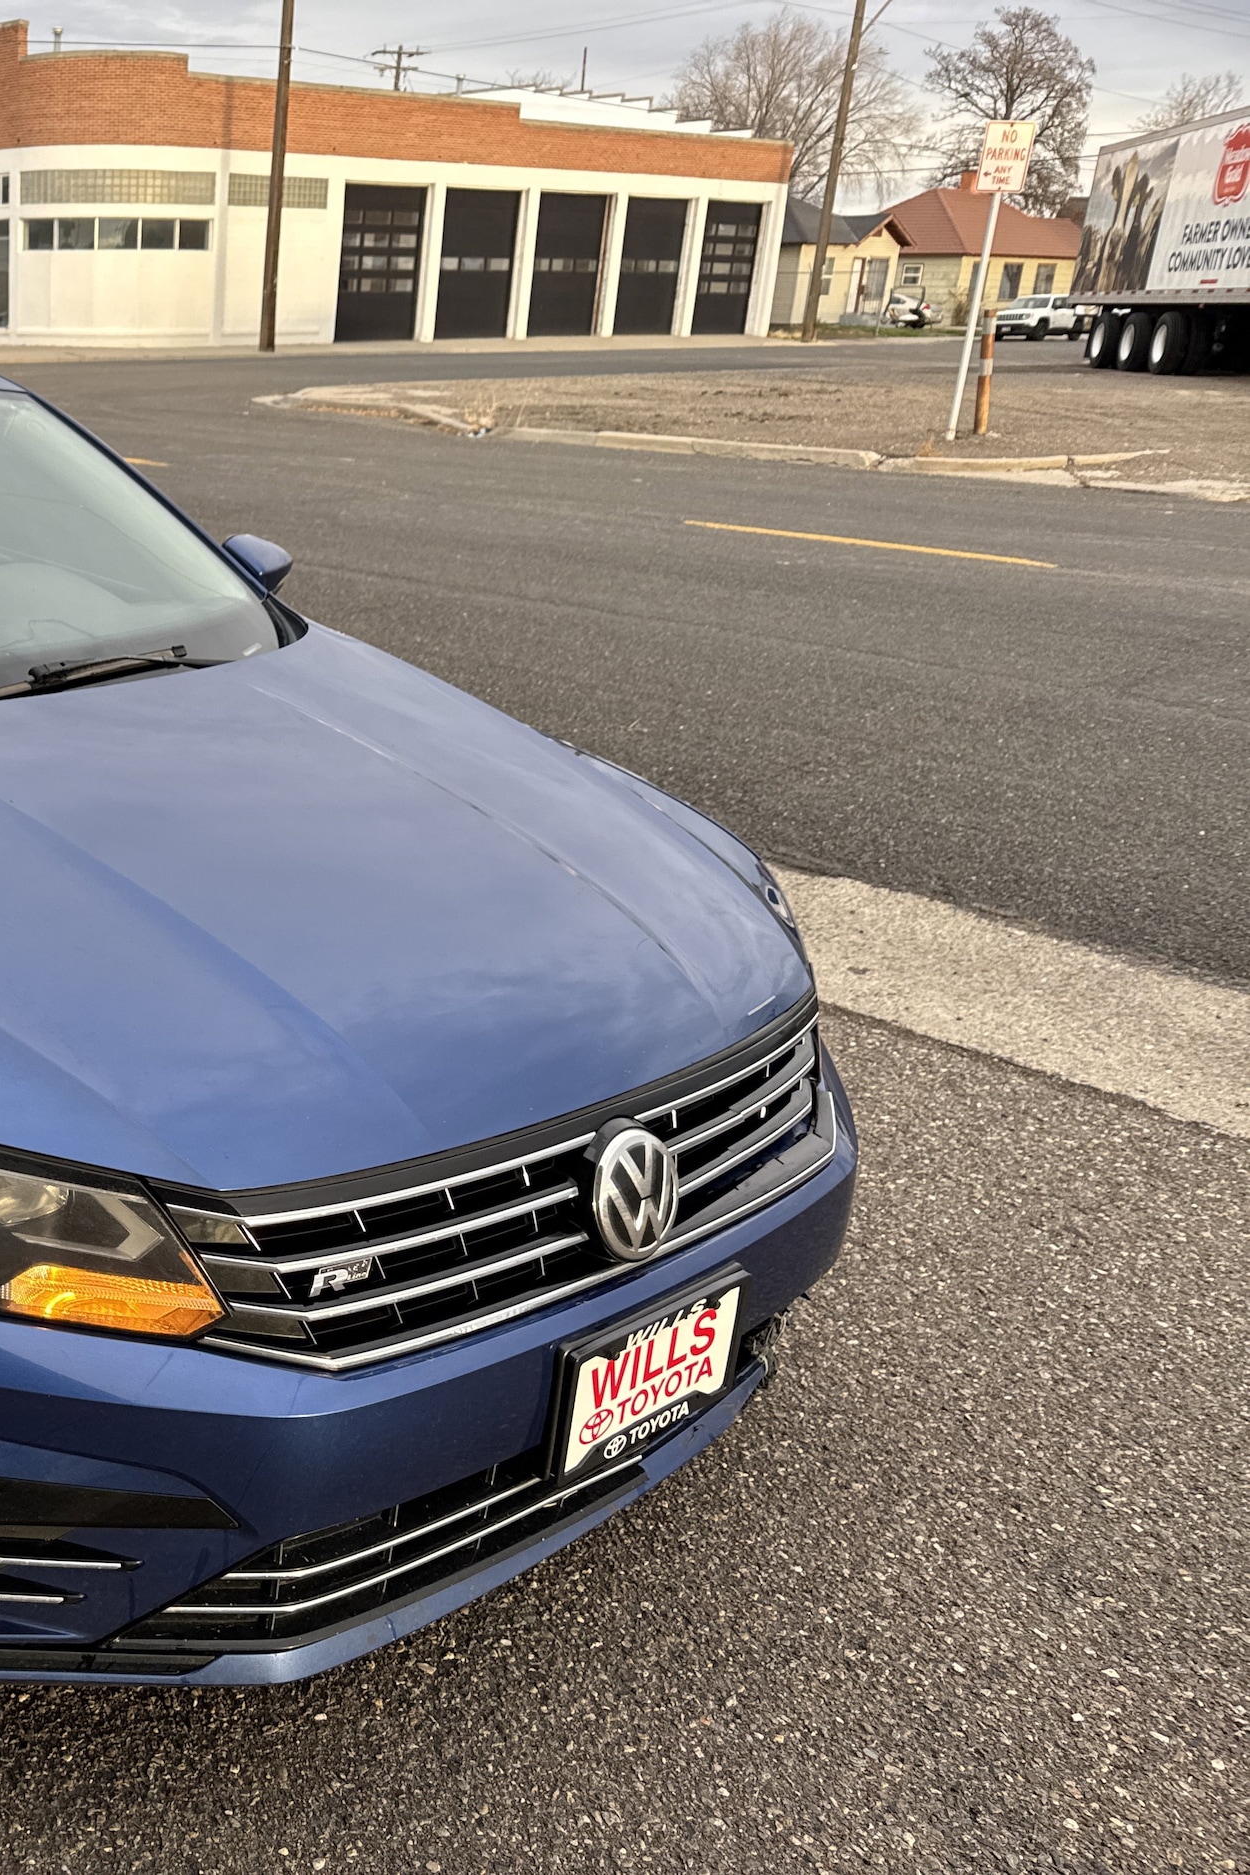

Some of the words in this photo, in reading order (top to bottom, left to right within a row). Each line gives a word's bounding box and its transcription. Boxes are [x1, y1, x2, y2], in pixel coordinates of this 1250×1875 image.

[1001, 129, 1018, 143] NO
[985, 147, 1027, 161] PARKING
[992, 176, 1011, 185] TIME
[993, 165, 1013, 174] ANY
[1181, 220, 1221, 245] FARMER
[1168, 247, 1228, 273] COMMUNITY
[591, 1308, 717, 1410] WILLS
[617, 1356, 713, 1425] TOYOTA
[629, 1401, 690, 1445] TOYOTA
